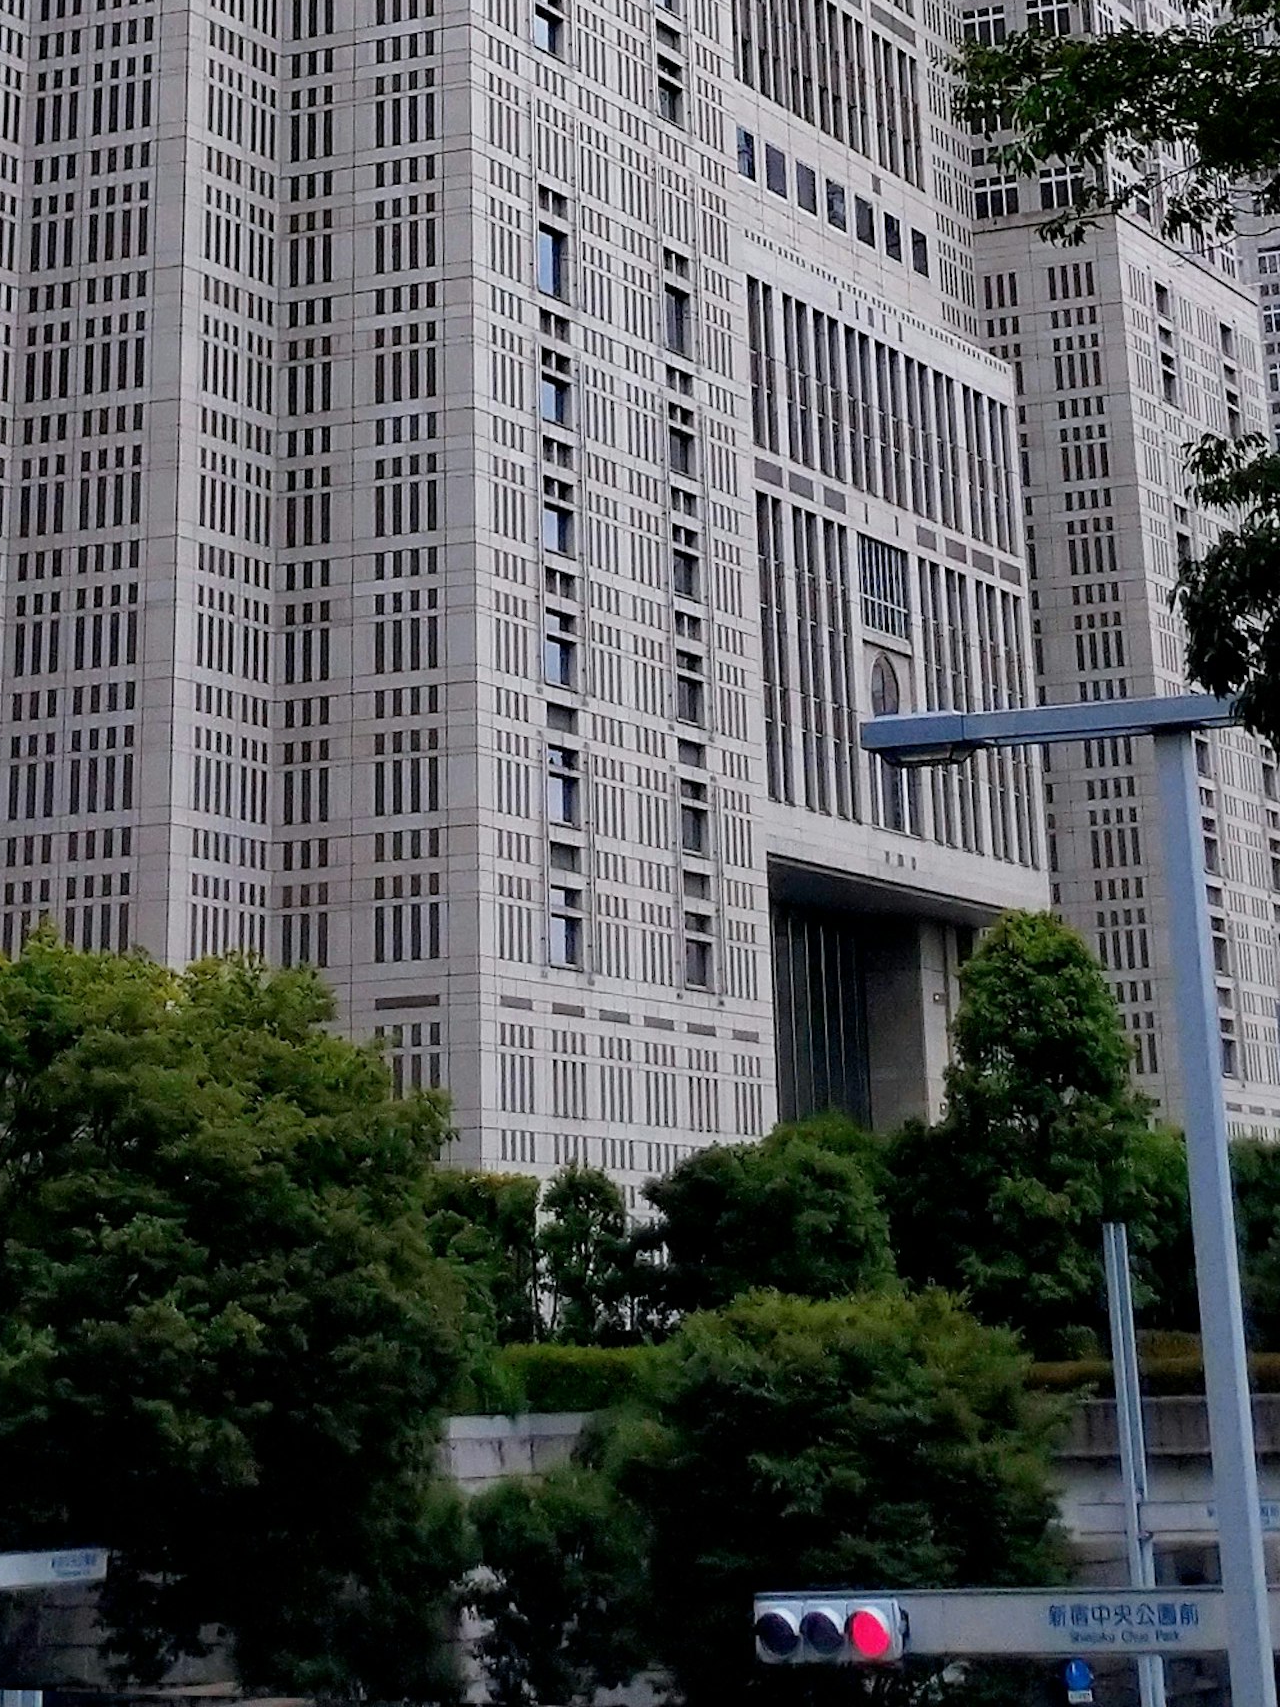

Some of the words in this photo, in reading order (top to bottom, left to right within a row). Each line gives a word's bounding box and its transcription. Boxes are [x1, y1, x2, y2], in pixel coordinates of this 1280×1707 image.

[1048, 1603, 1199, 1627] 新宿中央公園前
